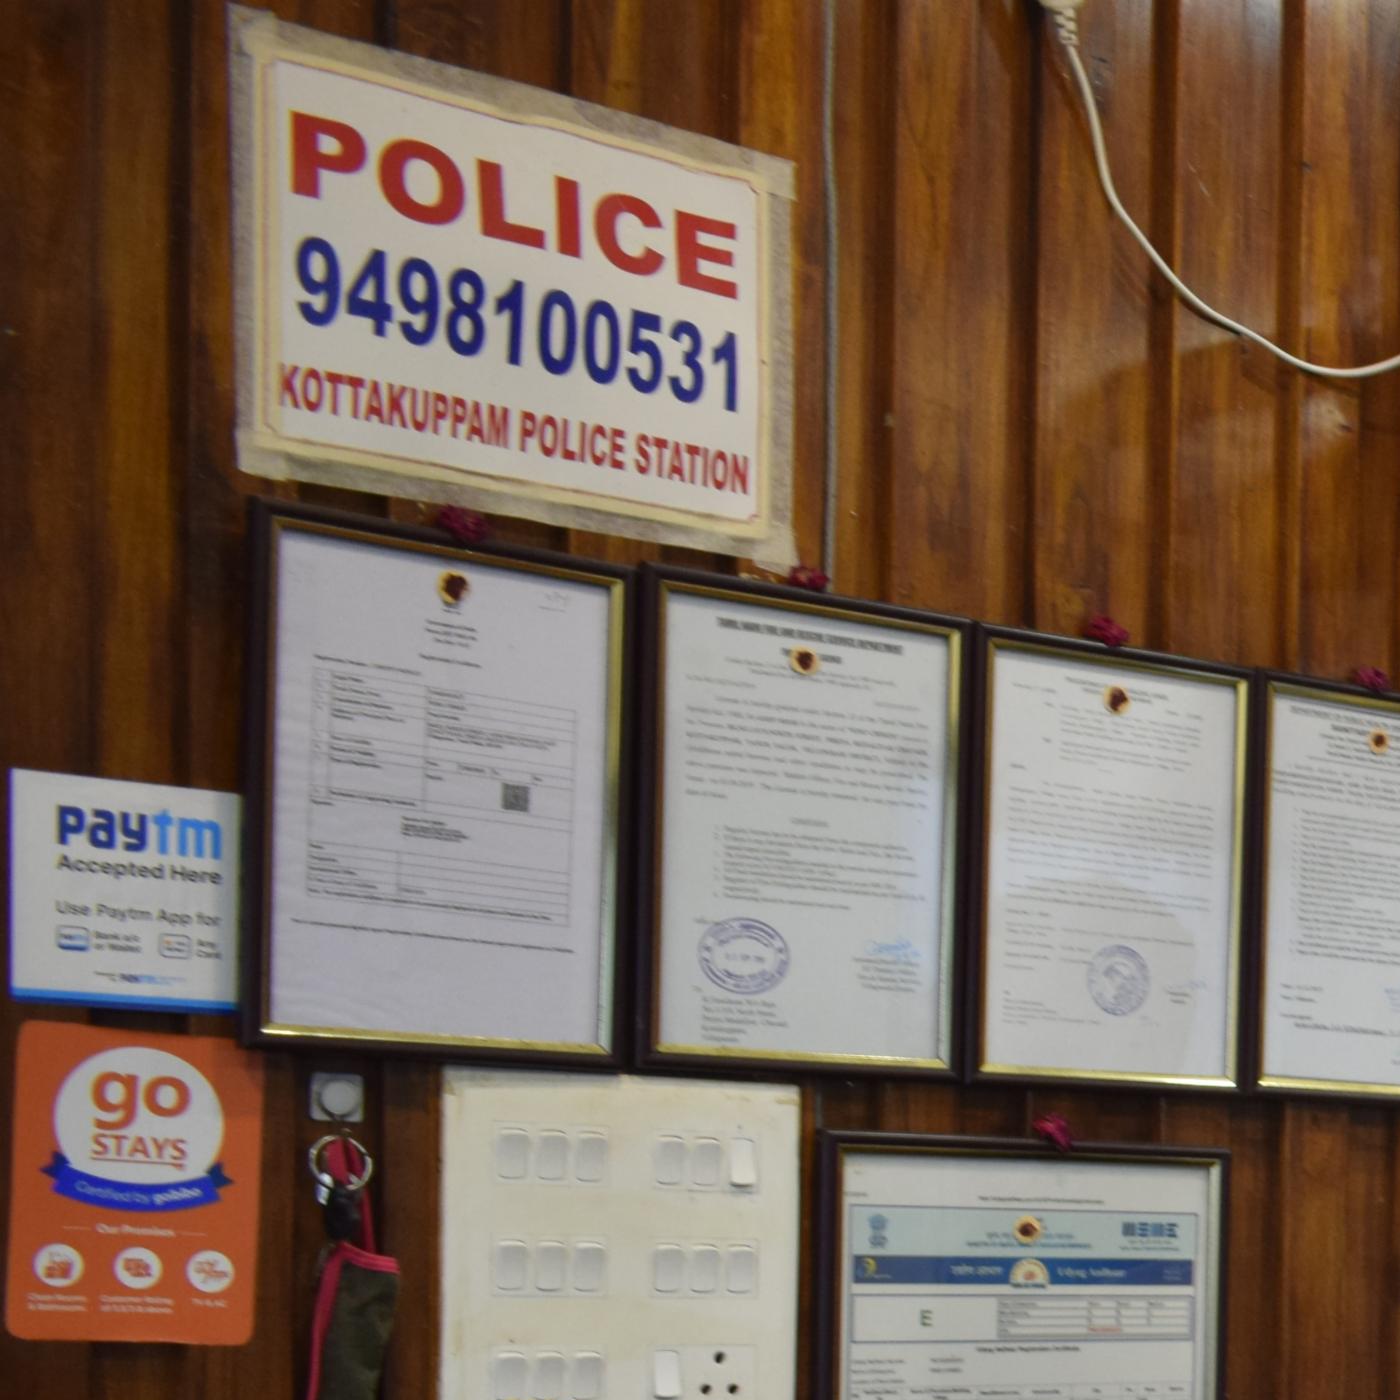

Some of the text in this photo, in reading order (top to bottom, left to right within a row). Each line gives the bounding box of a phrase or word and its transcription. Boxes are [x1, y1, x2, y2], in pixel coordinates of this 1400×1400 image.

[289, 109, 739, 300] POLICE
[296, 236, 739, 413] 9498100531
[280, 363, 750, 495] KOTTAKUPPAM POLICE STATION
[57, 854, 222, 884] Accepted Here
[91, 1070, 192, 1130] go
[91, 1134, 187, 1161] STAYS
